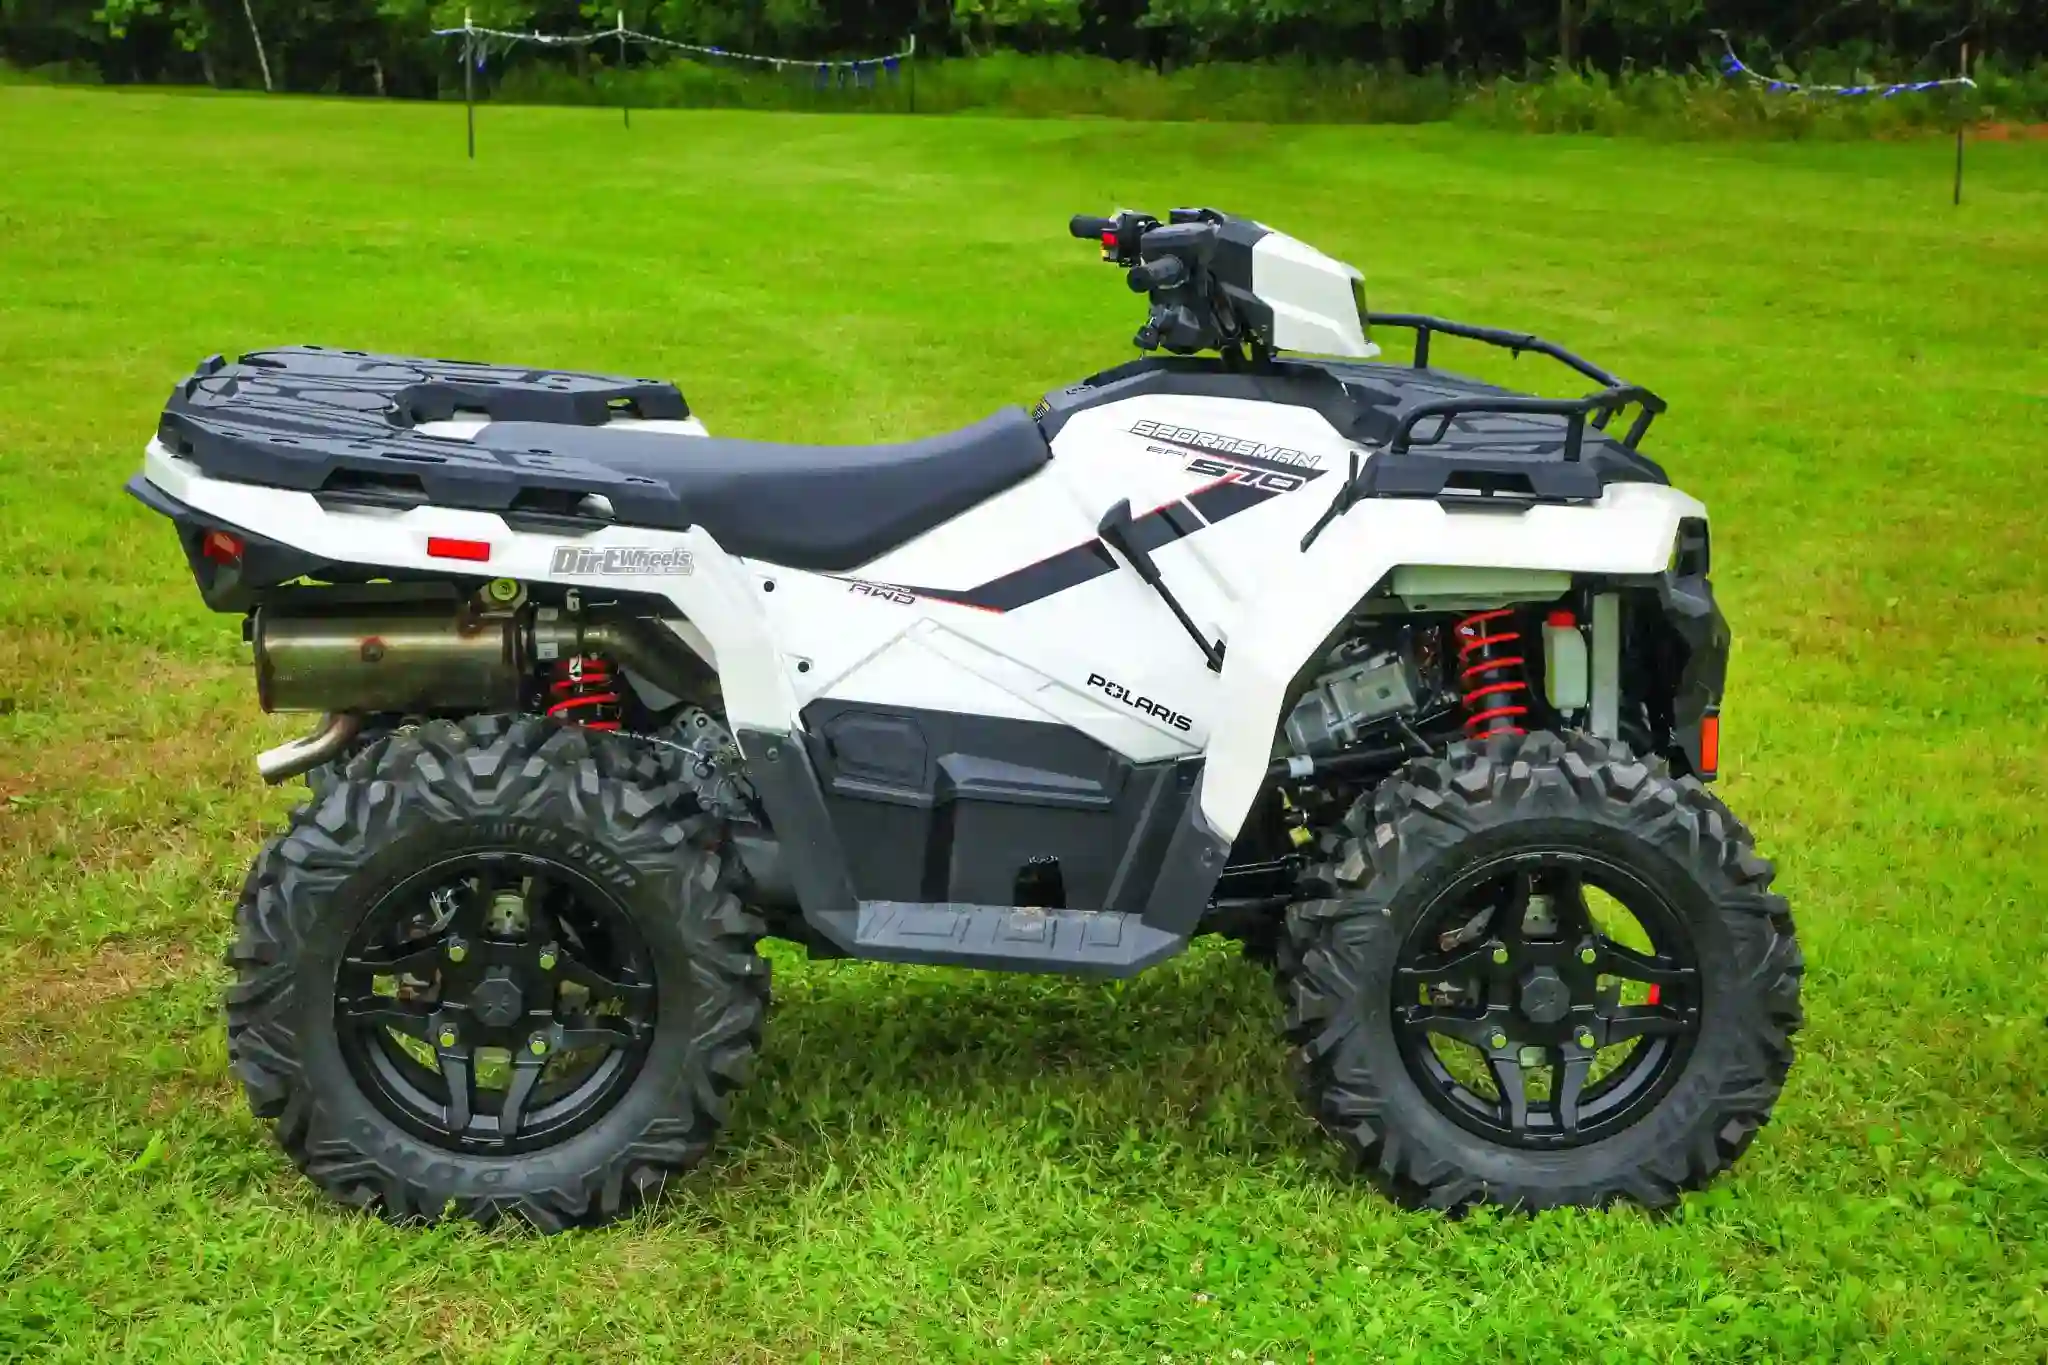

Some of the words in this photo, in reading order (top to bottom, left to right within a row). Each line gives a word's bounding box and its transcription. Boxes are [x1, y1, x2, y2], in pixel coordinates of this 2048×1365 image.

[1129, 419, 1322, 469] SPORTSMAN
[1185, 458, 1304, 492] 570
[848, 583, 916, 605] AWD
[1086, 673, 1193, 732] POLARIS
